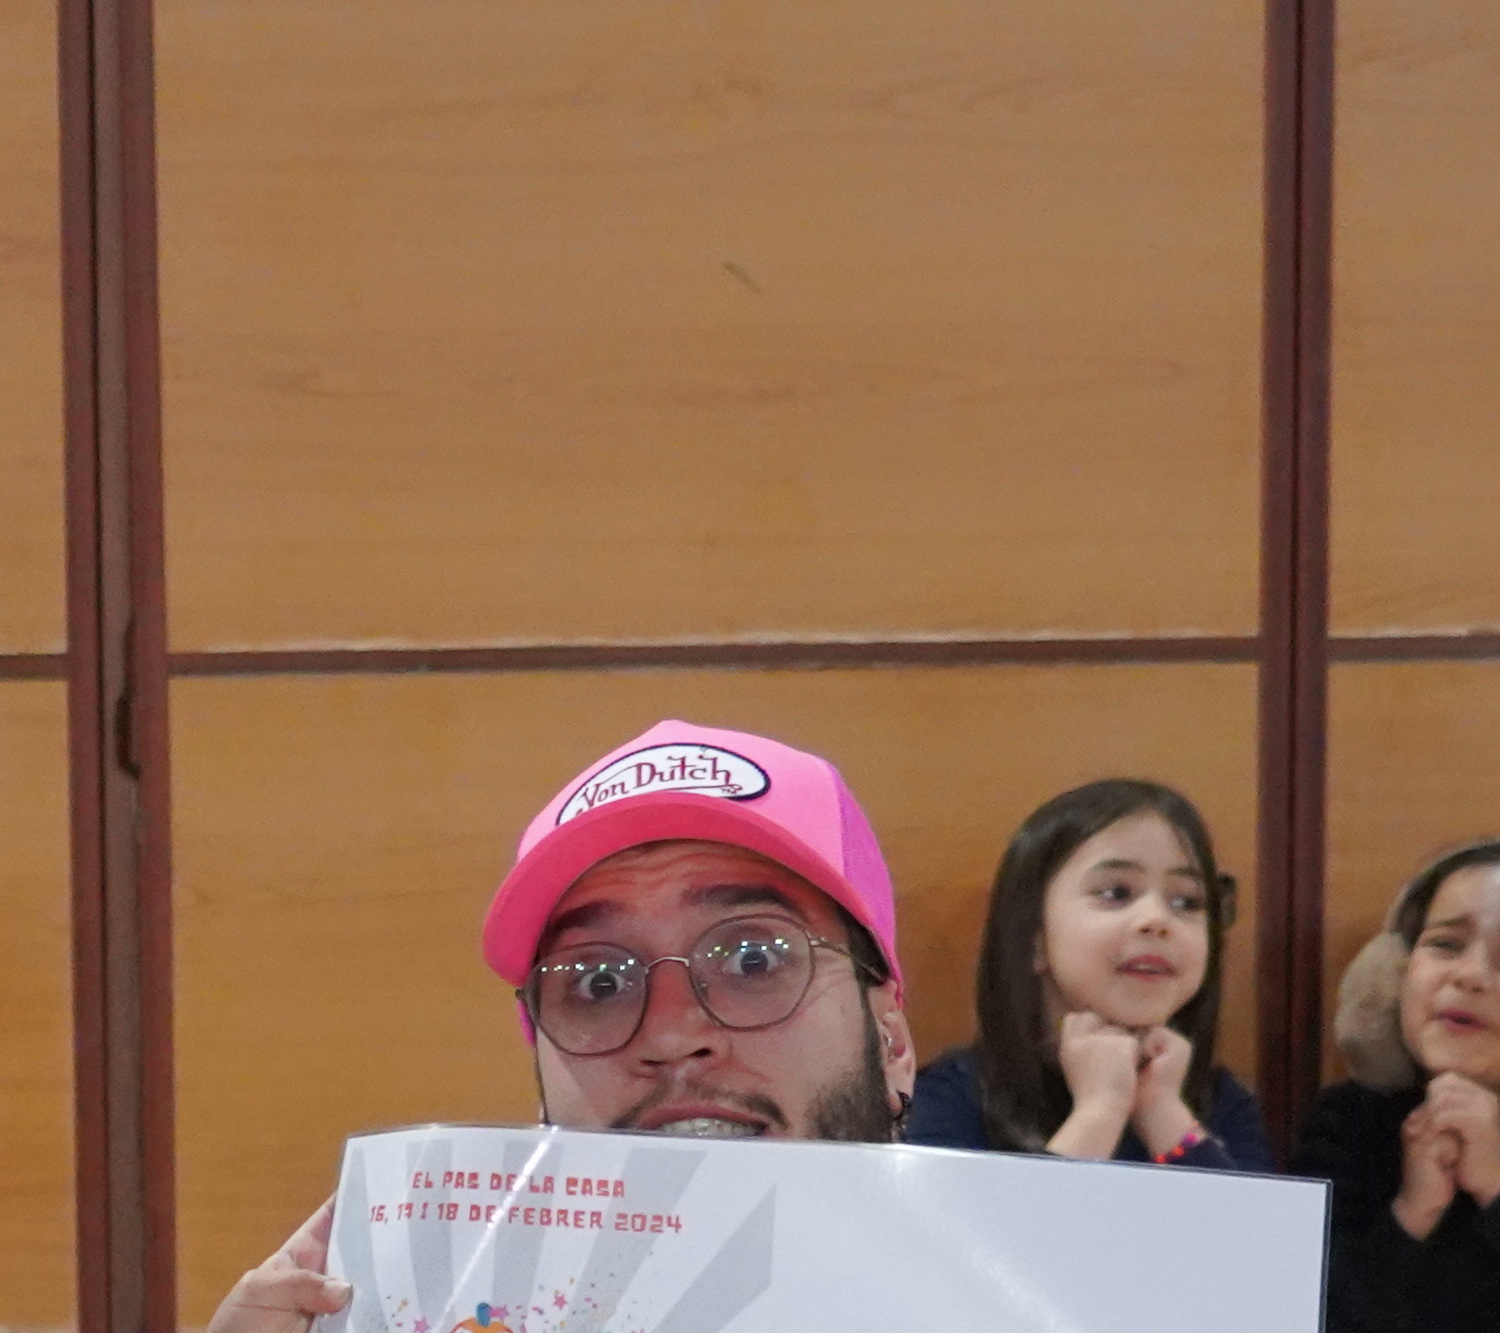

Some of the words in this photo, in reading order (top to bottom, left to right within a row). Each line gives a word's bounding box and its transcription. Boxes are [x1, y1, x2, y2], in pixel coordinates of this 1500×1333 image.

[576, 781, 629, 816] Von
[632, 754, 734, 791] Dutch
[412, 1171, 434, 1189] EL
[442, 1171, 480, 1190] PAS
[489, 1173, 518, 1192] DE
[528, 1175, 555, 1195] LA
[565, 1176, 626, 1199] CASA
[437, 1203, 460, 1222] 18
[468, 1204, 496, 1223] DE
[507, 1206, 603, 1230] FEBRER
[613, 1213, 683, 1235] 2024
